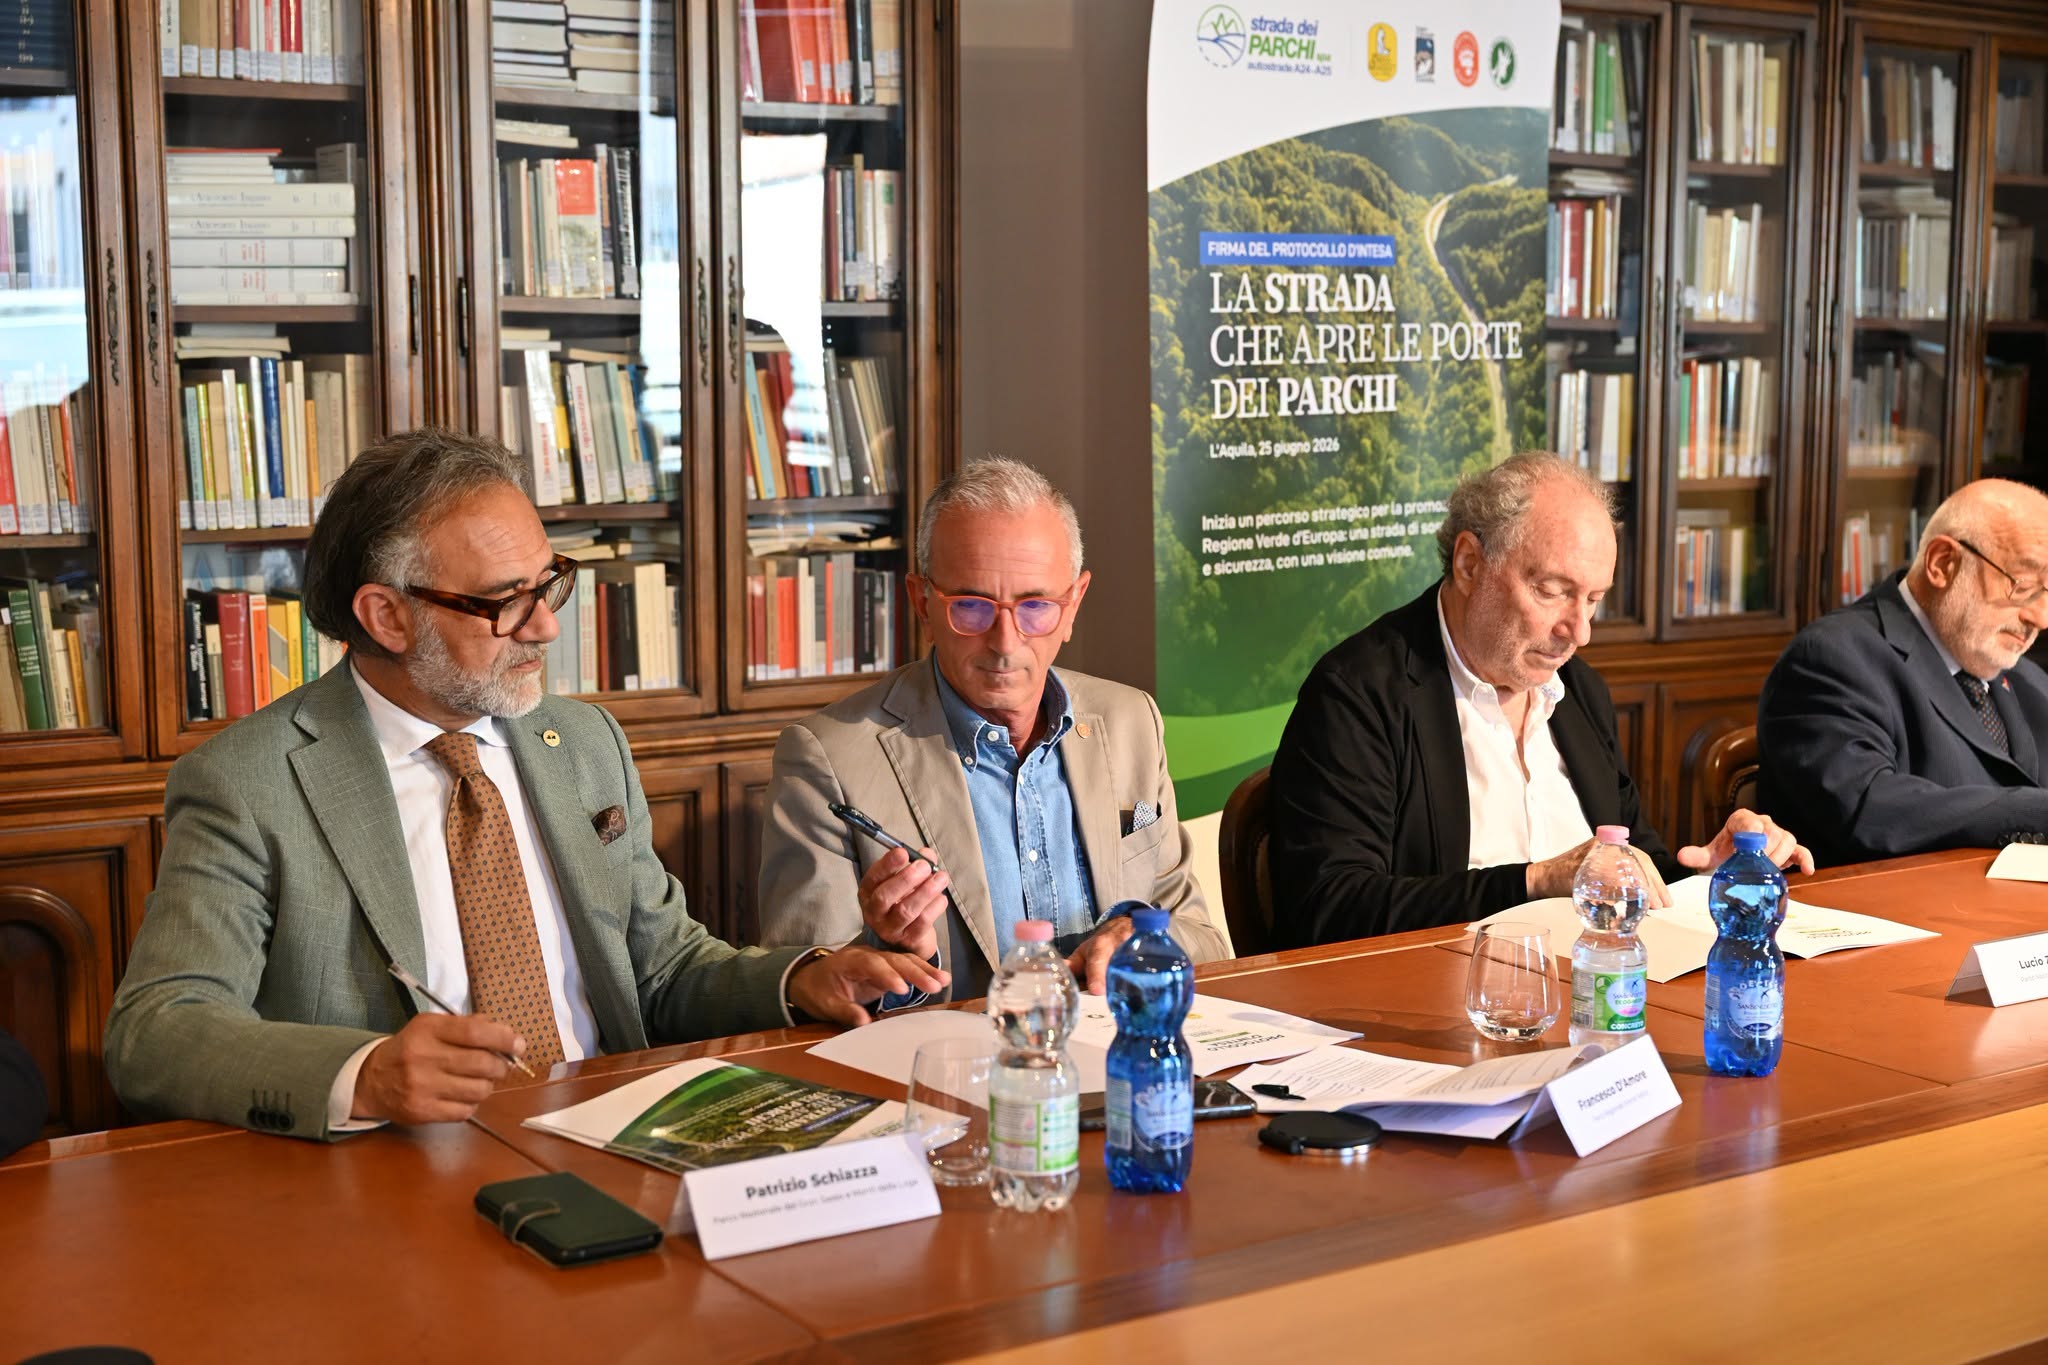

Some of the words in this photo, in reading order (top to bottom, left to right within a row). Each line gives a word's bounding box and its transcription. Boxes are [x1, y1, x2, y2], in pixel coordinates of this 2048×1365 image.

[1251, 16, 1293, 34] strada
[1297, 19, 1318, 36] dei
[1249, 34, 1316, 60] PARCHI
[1247, 62, 1292, 72] autostrade
[1208, 241, 1247, 257] FIRMA
[1249, 241, 1271, 257] DEL
[1273, 242, 1346, 258] PROTOCOLLO
[1348, 243, 1393, 259] D'INTESA
[1209, 272, 1259, 314] LA
[1264, 272, 1396, 314] STRADA
[1210, 325, 1284, 367] CHE
[1290, 323, 1376, 365] APRE
[1381, 322, 1422, 362] LE
[1430, 321, 1523, 361] PORTE
[1210, 378, 1270, 420] DEI
[1277, 373, 1398, 417] PARCHI
[1209, 441, 1257, 459] L'Aquila,
[1258, 440, 1272, 456] 25
[1273, 440, 1311, 458] giugno
[1312, 437, 1340, 453] 2026
[1202, 513, 1236, 531] Inizia
[1238, 515, 1254, 529] un
[1255, 510, 1309, 530] percorso
[1311, 504, 1370, 523] strategico
[1371, 504, 1390, 519] per
[1391, 500, 1403, 515] la
[1202, 537, 1254, 555] Regione
[1255, 532, 1290, 549] Verde
[1292, 529, 1347, 546] d'Europa:
[1349, 527, 1369, 541] una
[1370, 522, 1406, 539] strada
[1407, 520, 1419, 536] di
[1202, 563, 1212, 577] e
[1214, 558, 1274, 575] sicurezza,
[1276, 555, 1299, 569] con
[1301, 553, 1324, 567] una
[1326, 548, 1366, 565] visione
[1367, 544, 1414, 560] comune.
[2018, 956, 2044, 969] Lucio
[1207, 1034, 1285, 1052] PROTOCOLLO
[1577, 1086, 1616, 1111] Francesco
[745, 1177, 808, 1200] Patrizio
[811, 1164, 879, 1188] Schiazza
